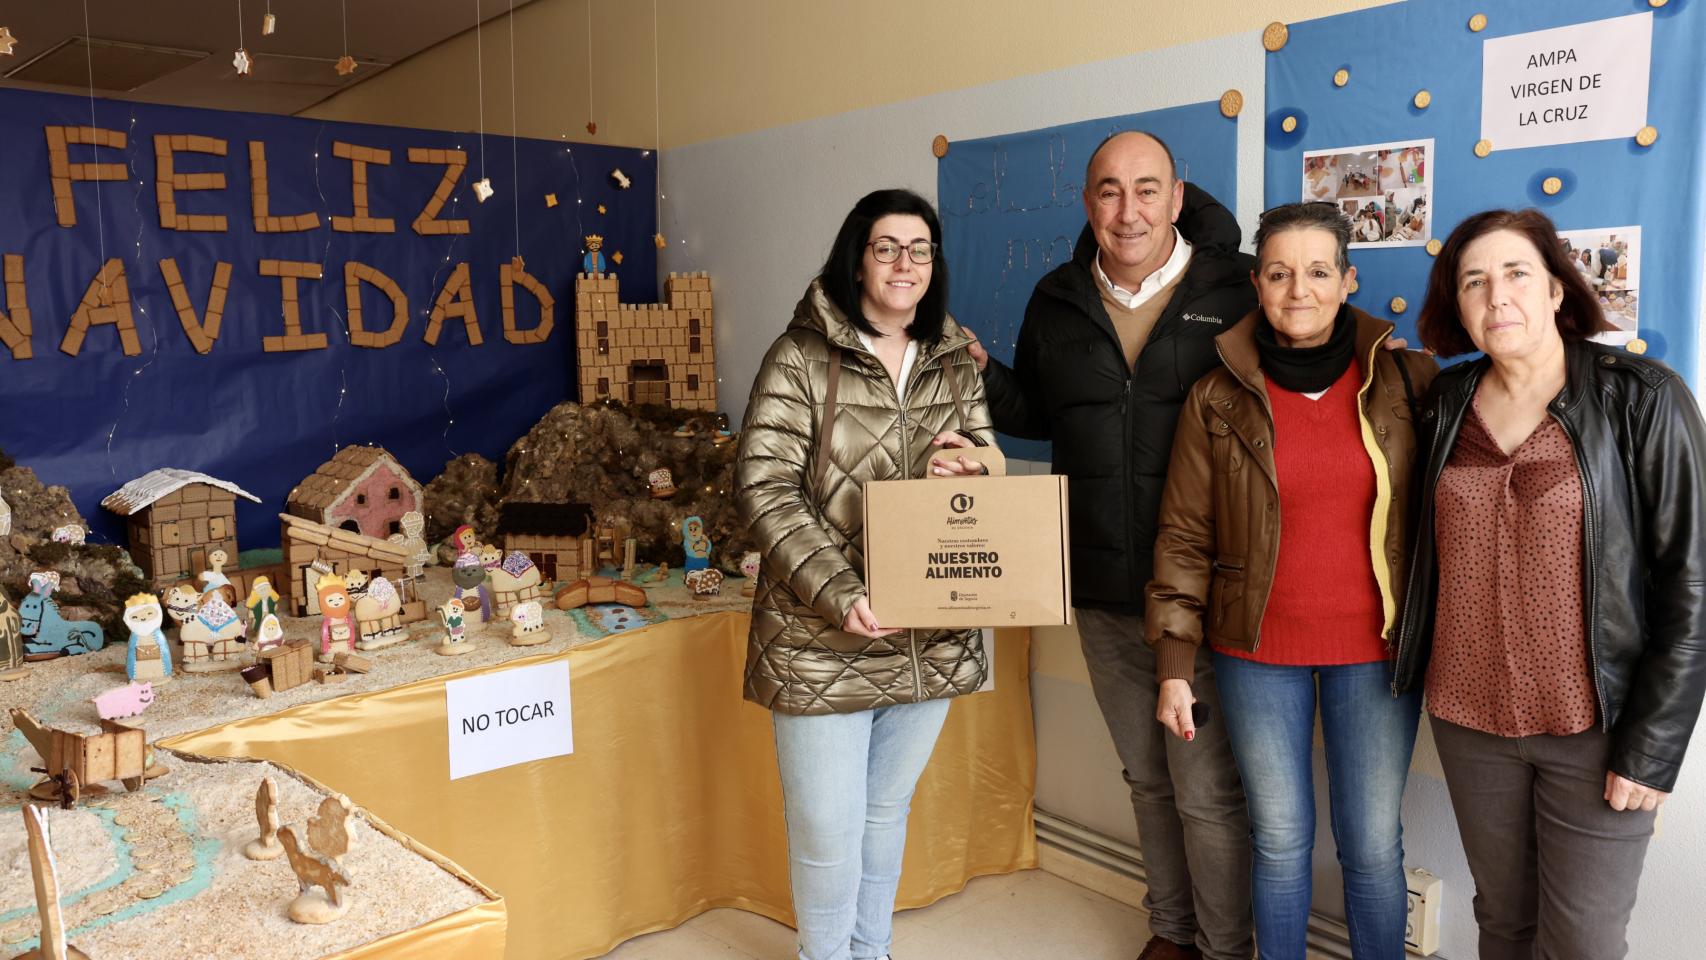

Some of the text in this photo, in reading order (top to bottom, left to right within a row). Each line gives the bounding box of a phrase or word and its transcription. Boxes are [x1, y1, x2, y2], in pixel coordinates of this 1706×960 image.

[1526, 48, 1577, 69] AMPA
[1510, 73, 1602, 99] VIRGEN DE
[1519, 104, 1588, 126] LA CRUZ
[45, 125, 471, 236] FELIZ
[1190, 313, 1222, 324] Columbia
[928, 551, 999, 565] NUESTRO
[925, 566, 1003, 579] ALIMENTO
[462, 700, 555, 735] NO TOCAR
